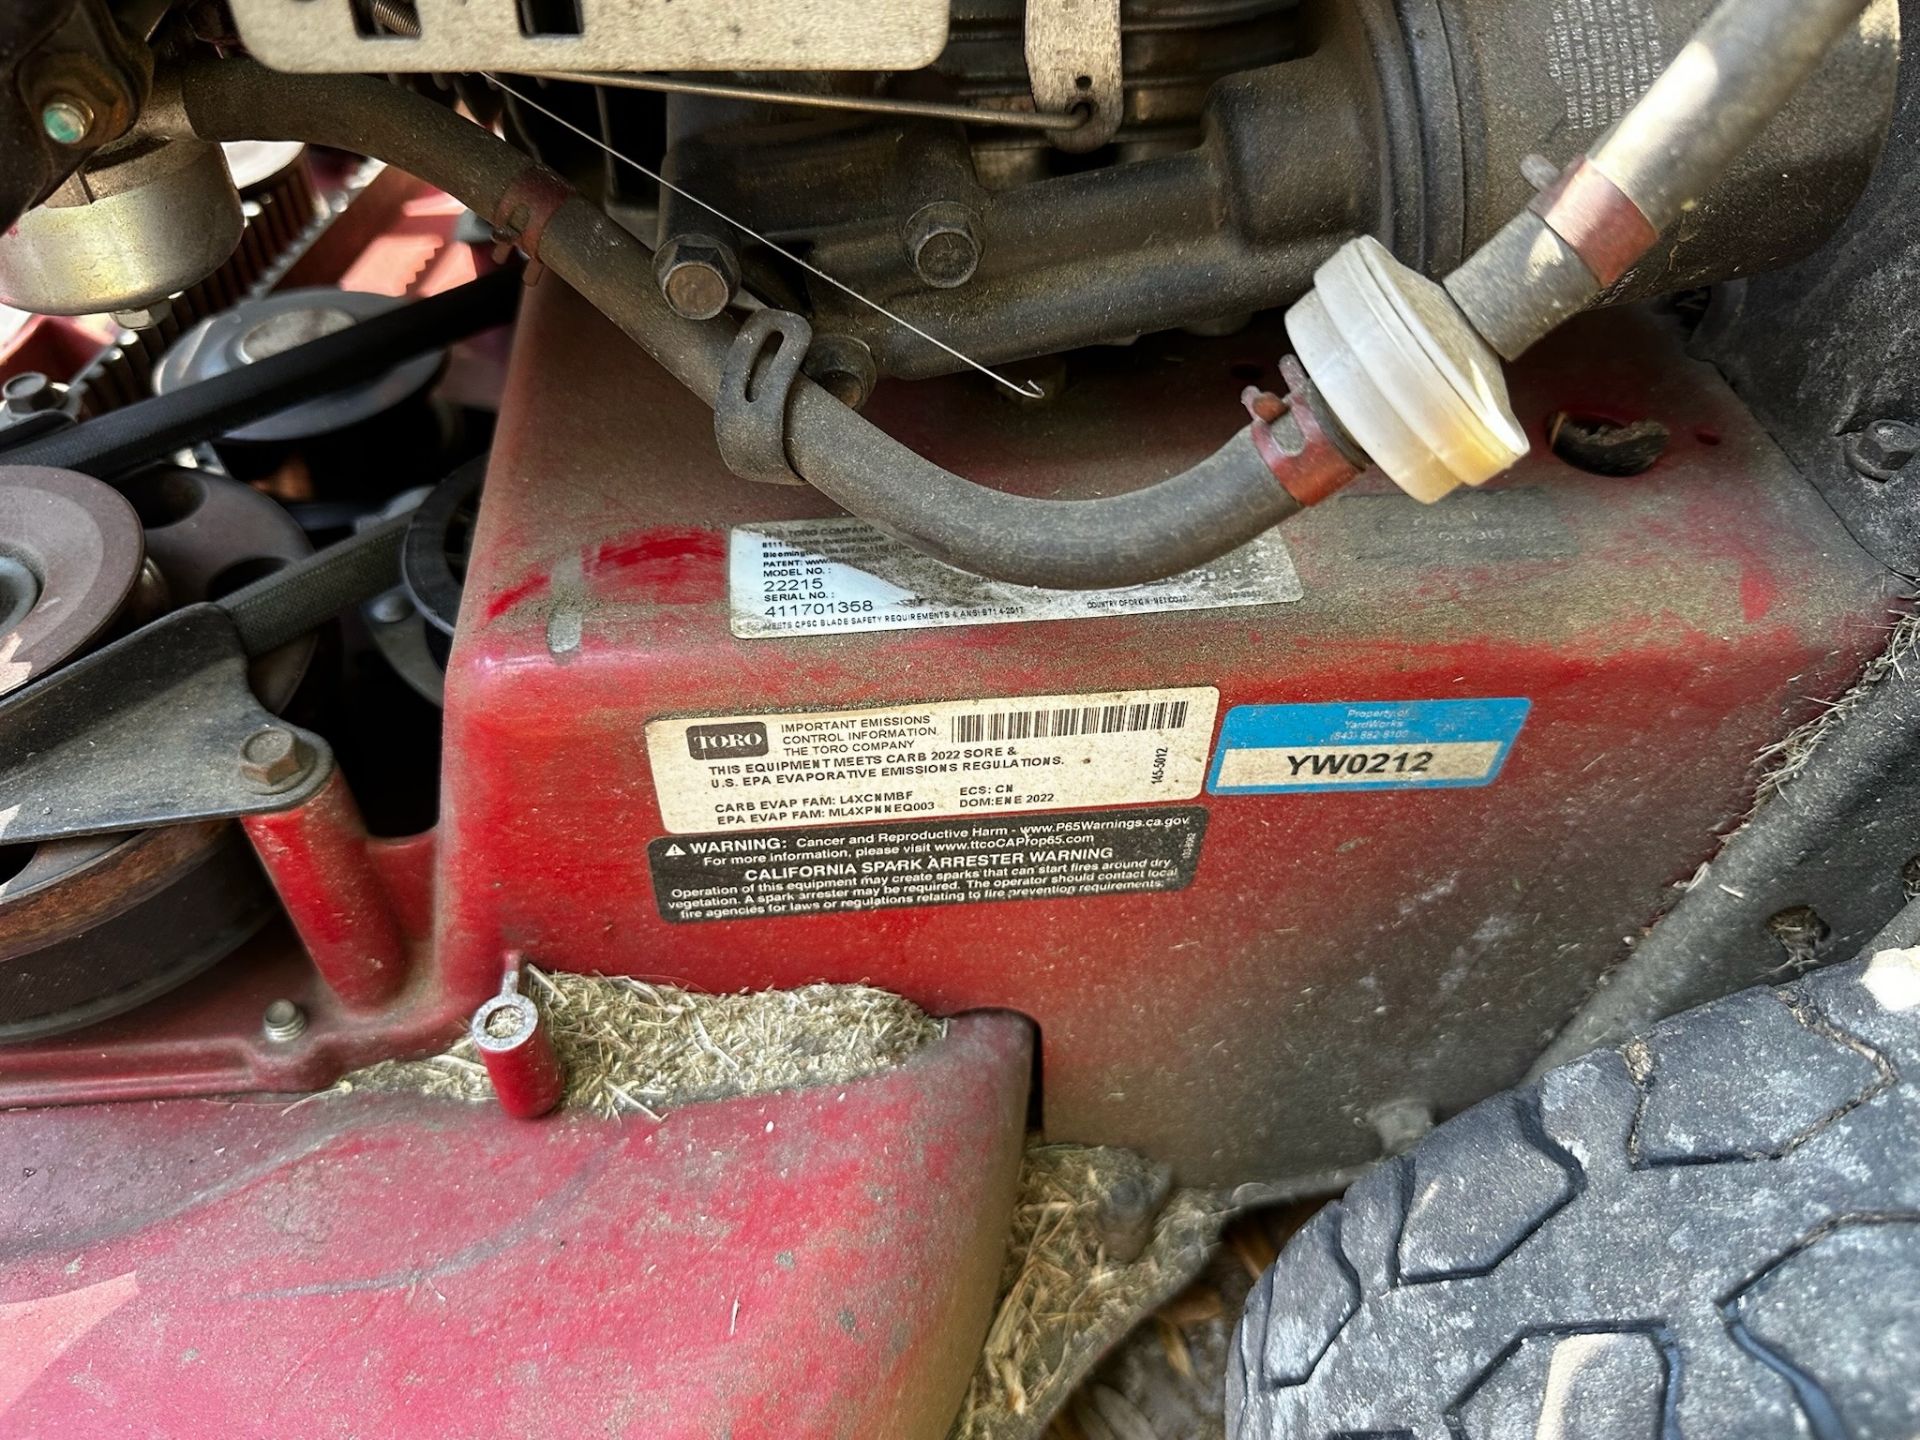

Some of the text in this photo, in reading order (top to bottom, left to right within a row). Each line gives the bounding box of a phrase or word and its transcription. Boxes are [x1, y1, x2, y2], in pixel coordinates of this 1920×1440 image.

[764, 569, 802, 578] MODEL
[806, 567, 825, 575] NO.
[764, 578, 823, 592] 22215
[764, 593, 806, 602] SERIAL
[764, 600, 874, 617] 411701358
[795, 620, 817, 628] CPSC
[820, 618, 848, 626] BLADE
[852, 616, 882, 625] SAFETY
[885, 611, 950, 622] REQUIREMENTS
[1347, 708, 1393, 719] Property
[782, 715, 931, 733] IMPORTANT EMISSIONS
[1344, 719, 1404, 729] YardWorks
[694, 732, 762, 749] TORO
[782, 727, 936, 745] CONTROL INFORMATION
[784, 740, 915, 757] THE TORO COMPANY
[708, 748, 1017, 775] THIS EQUIPMENT MEETS CARB 2022 SORE &
[1151, 747, 1168, 784] 145-5012
[1287, 752, 1434, 775] YW0212
[711, 757, 1064, 788] U.S. EPA EVAPORATIVE EMISSIONS REGULATIONS.
[960, 785, 992, 796] ECS:
[1026, 794, 1054, 804] 2022
[715, 792, 913, 813] CARB EVAP FAM: L4XCNMBF
[718, 815, 747, 825] EPA
[750, 812, 787, 823] EVAP
[792, 810, 825, 821] FAM:
[690, 837, 787, 854] WARNING:
[796, 835, 845, 848] Cancer
[849, 833, 874, 845] and
[878, 827, 968, 845] Reproductive
[972, 825, 1008, 837] Harm
[1020, 814, 1190, 837] www.P65Warnings.ca.gov
[704, 834, 1094, 866] For more information, please visit www.ttcoCAProp65.com
[744, 848, 1113, 881] CALIFORNIA SPARK ARRESTER WARNING
[671, 859, 1172, 900] Operation of this equipment may create sparks that can start fires around dry
[668, 869, 1178, 911] vegetation. A spark arrester may be required. The operator should contact local
[680, 908, 703, 919] fire
[706, 904, 765, 919] agencies
[768, 903, 786, 913] for
[790, 901, 820, 912] laws
[824, 902, 837, 910] or
[840, 895, 913, 911] regulations
[916, 892, 965, 907] relating
[968, 891, 981, 901] to
[984, 890, 1004, 900] fire
[1008, 886, 1075, 901] prevention
